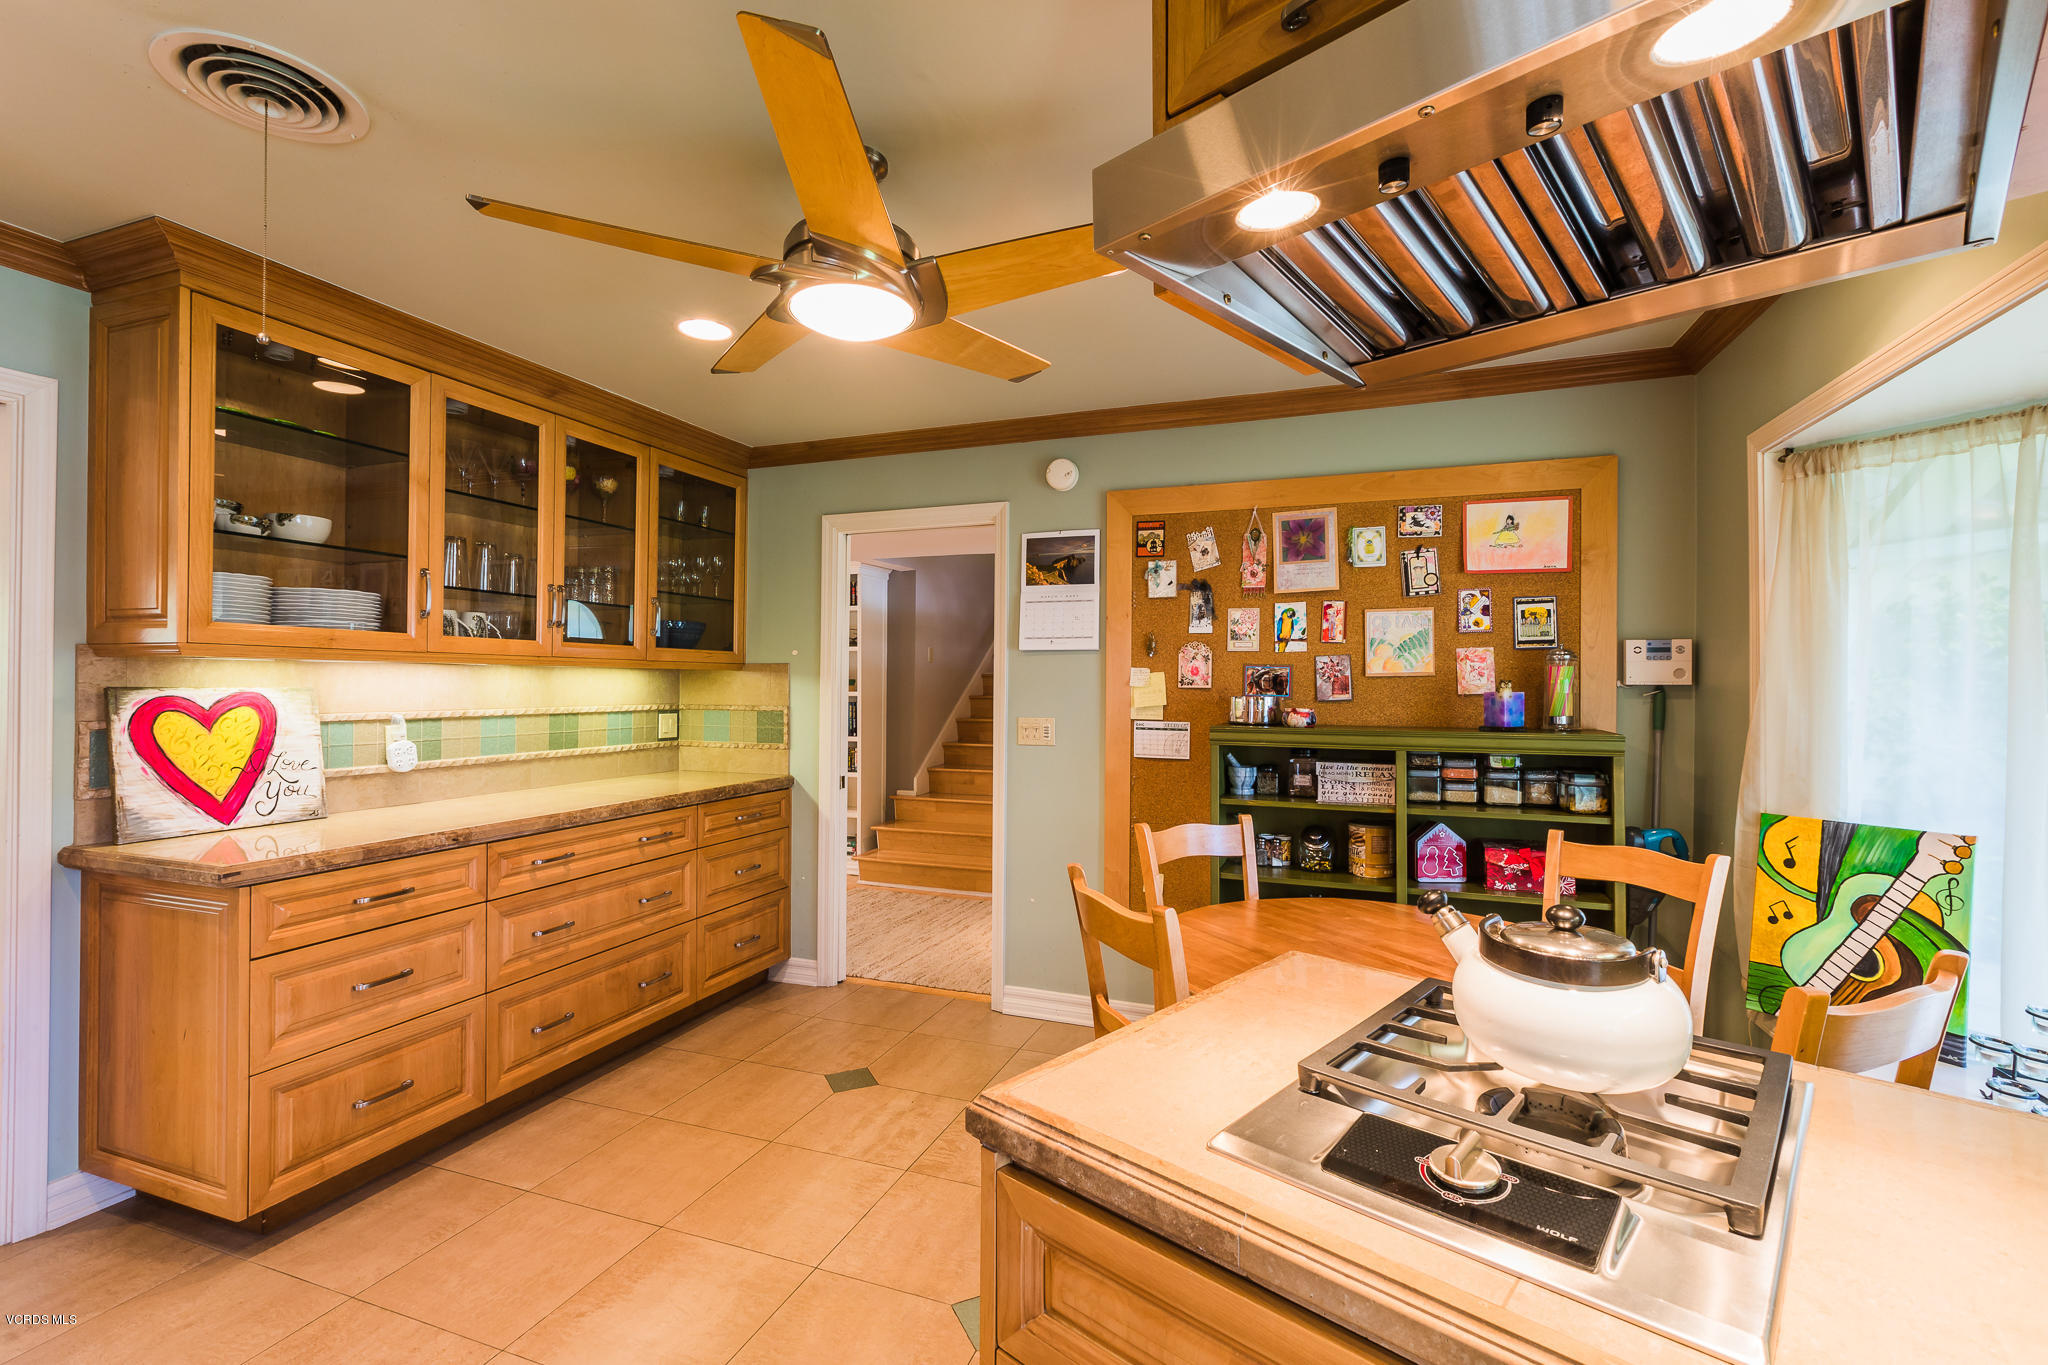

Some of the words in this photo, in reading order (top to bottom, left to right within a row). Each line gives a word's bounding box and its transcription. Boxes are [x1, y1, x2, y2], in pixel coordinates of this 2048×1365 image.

[268, 751, 317, 784] Love
[255, 780, 317, 817] You
[1343, 791, 1393, 799] generously
[1536, 1224, 1579, 1243] WOLF
